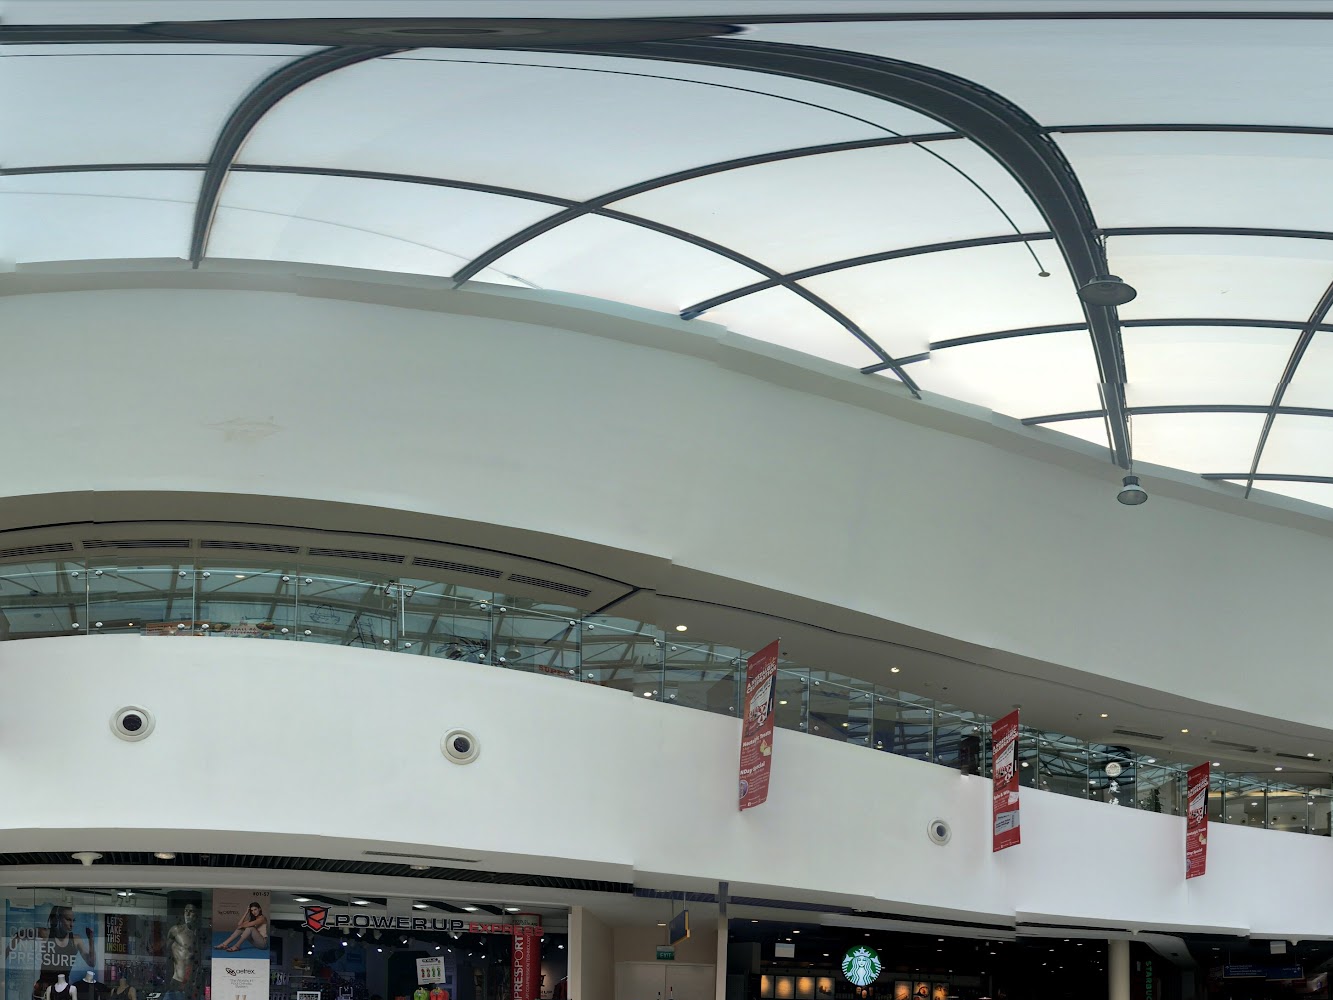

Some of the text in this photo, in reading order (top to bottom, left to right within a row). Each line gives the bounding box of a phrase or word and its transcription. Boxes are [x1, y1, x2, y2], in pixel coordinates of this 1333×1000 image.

[107, 916, 123, 926] LET'S
[9, 926, 43, 940] COOL
[107, 926, 122, 935] TAKE
[107, 935, 121, 943] THIS
[9, 939, 56, 953] UNDER
[107, 943, 126, 952] INSIDE
[9, 952, 77, 966] PRESSURE
